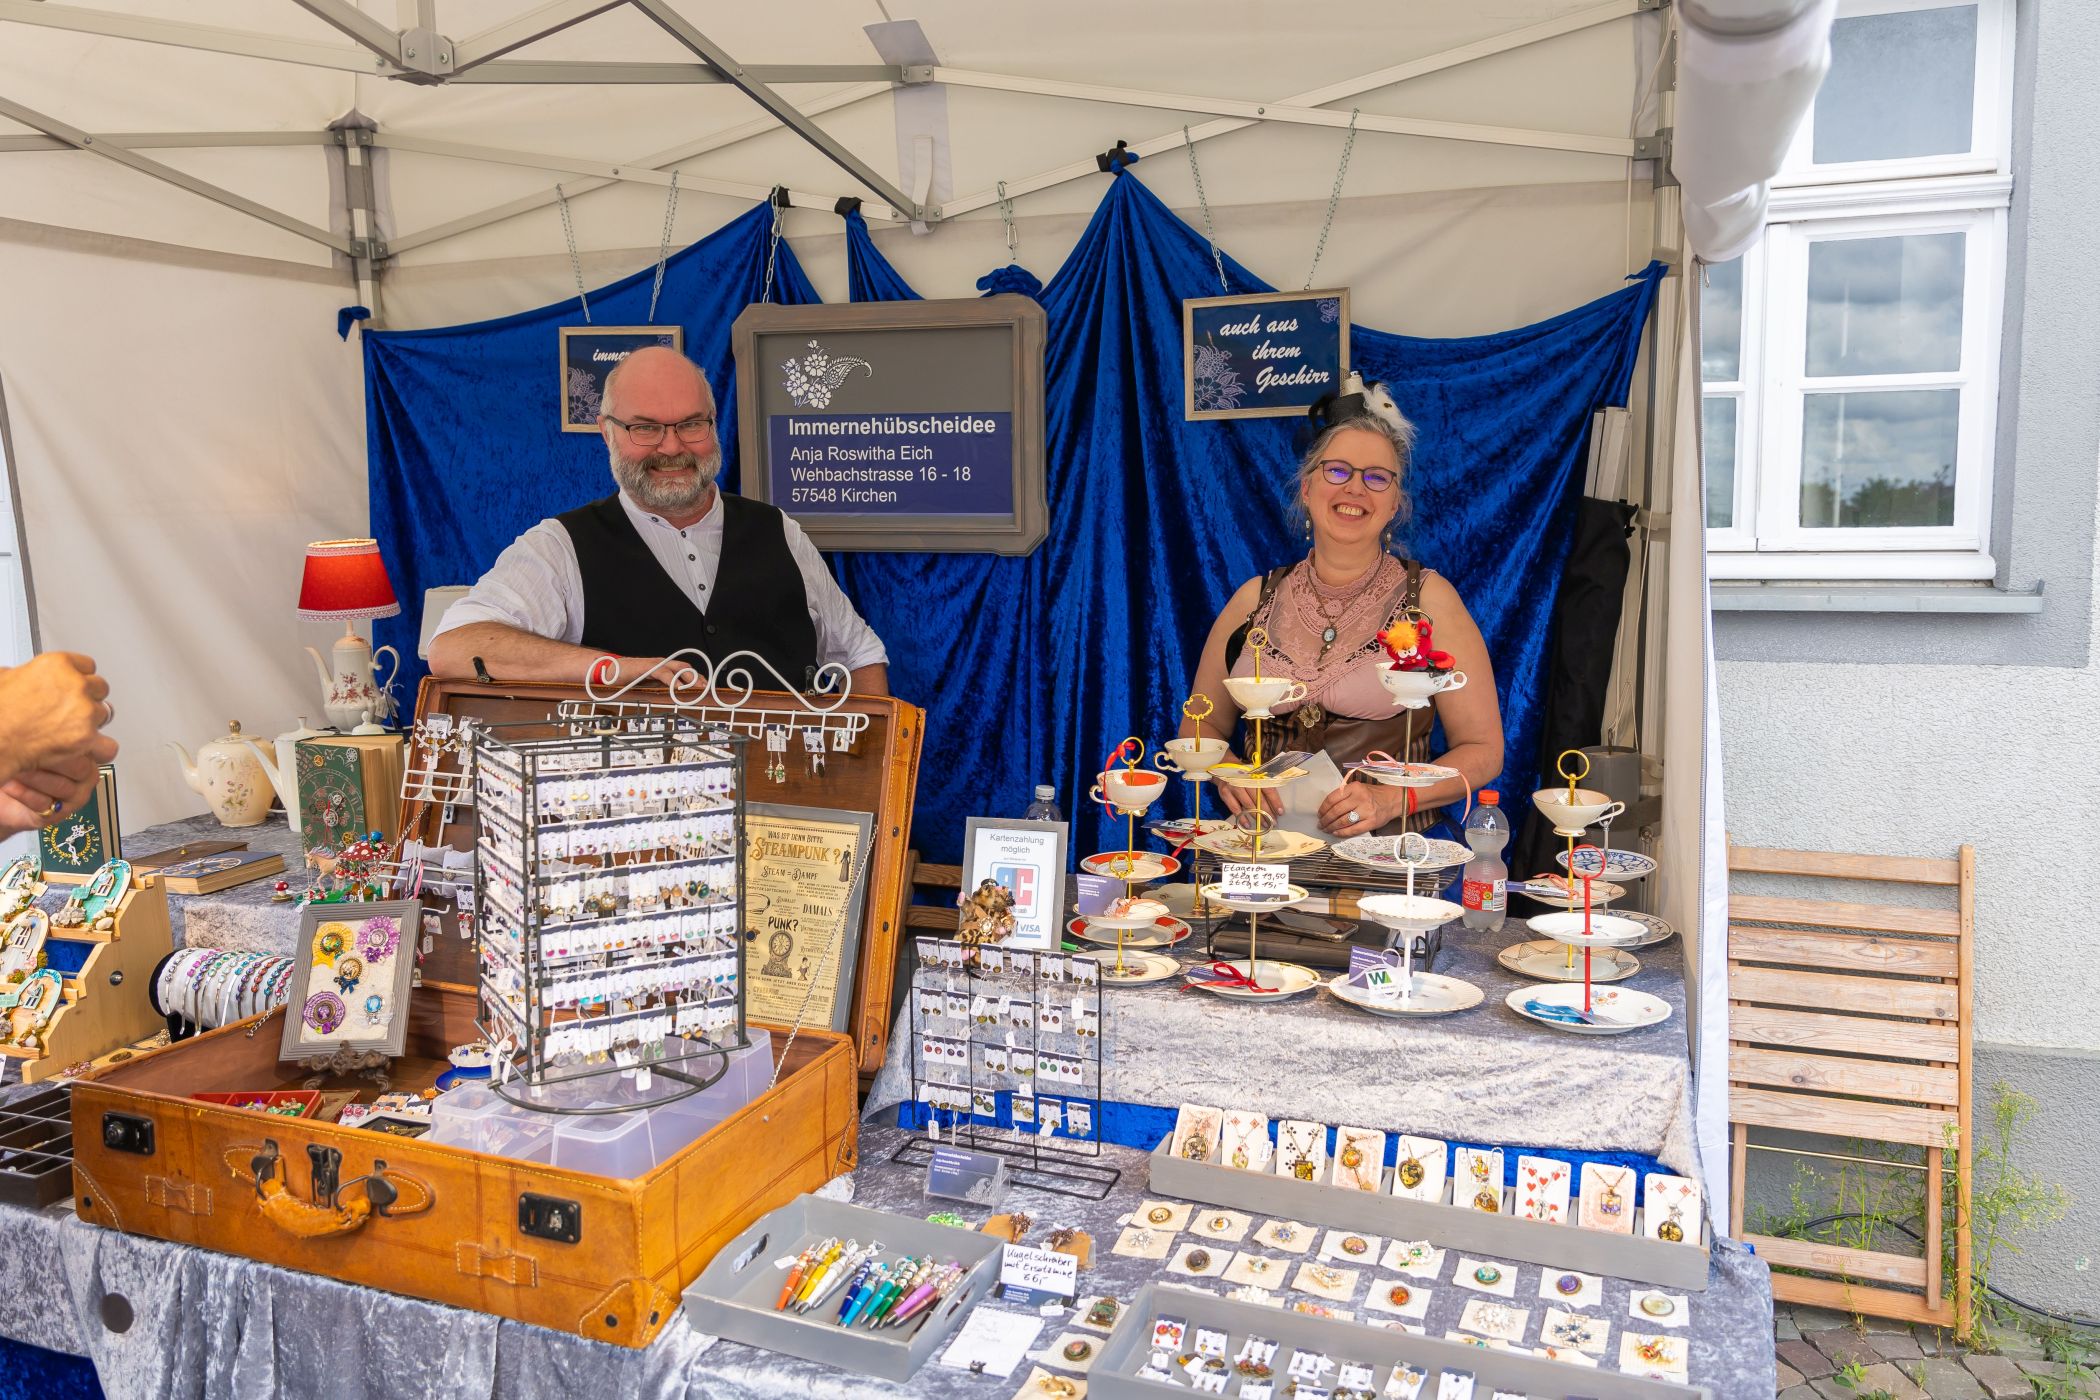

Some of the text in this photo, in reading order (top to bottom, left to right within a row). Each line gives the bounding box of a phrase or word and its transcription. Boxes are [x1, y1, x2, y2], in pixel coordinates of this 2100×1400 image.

[1220, 314, 1298, 336] auch aus
[1252, 340, 1302, 360] ihrem
[1256, 364, 1330, 394] Geschirr
[789, 416, 996, 436] Immernehübscheidee
[790, 446, 933, 464] Anja Roswitha Eich
[791, 468, 914, 482] Wehbachstrasse
[919, 466, 937, 481] 16
[953, 466, 971, 480] 18
[792, 488, 897, 502] 57548 Kirchen
[990, 834, 1045, 846] Kartenzahlung
[750, 837, 830, 862] STEAMPUNK
[1001, 846, 1030, 854] möglich
[761, 865, 786, 878] STEAM
[802, 904, 833, 916] DAMALS
[768, 916, 798, 932] PUNK?
[1020, 924, 1040, 932] VISA
